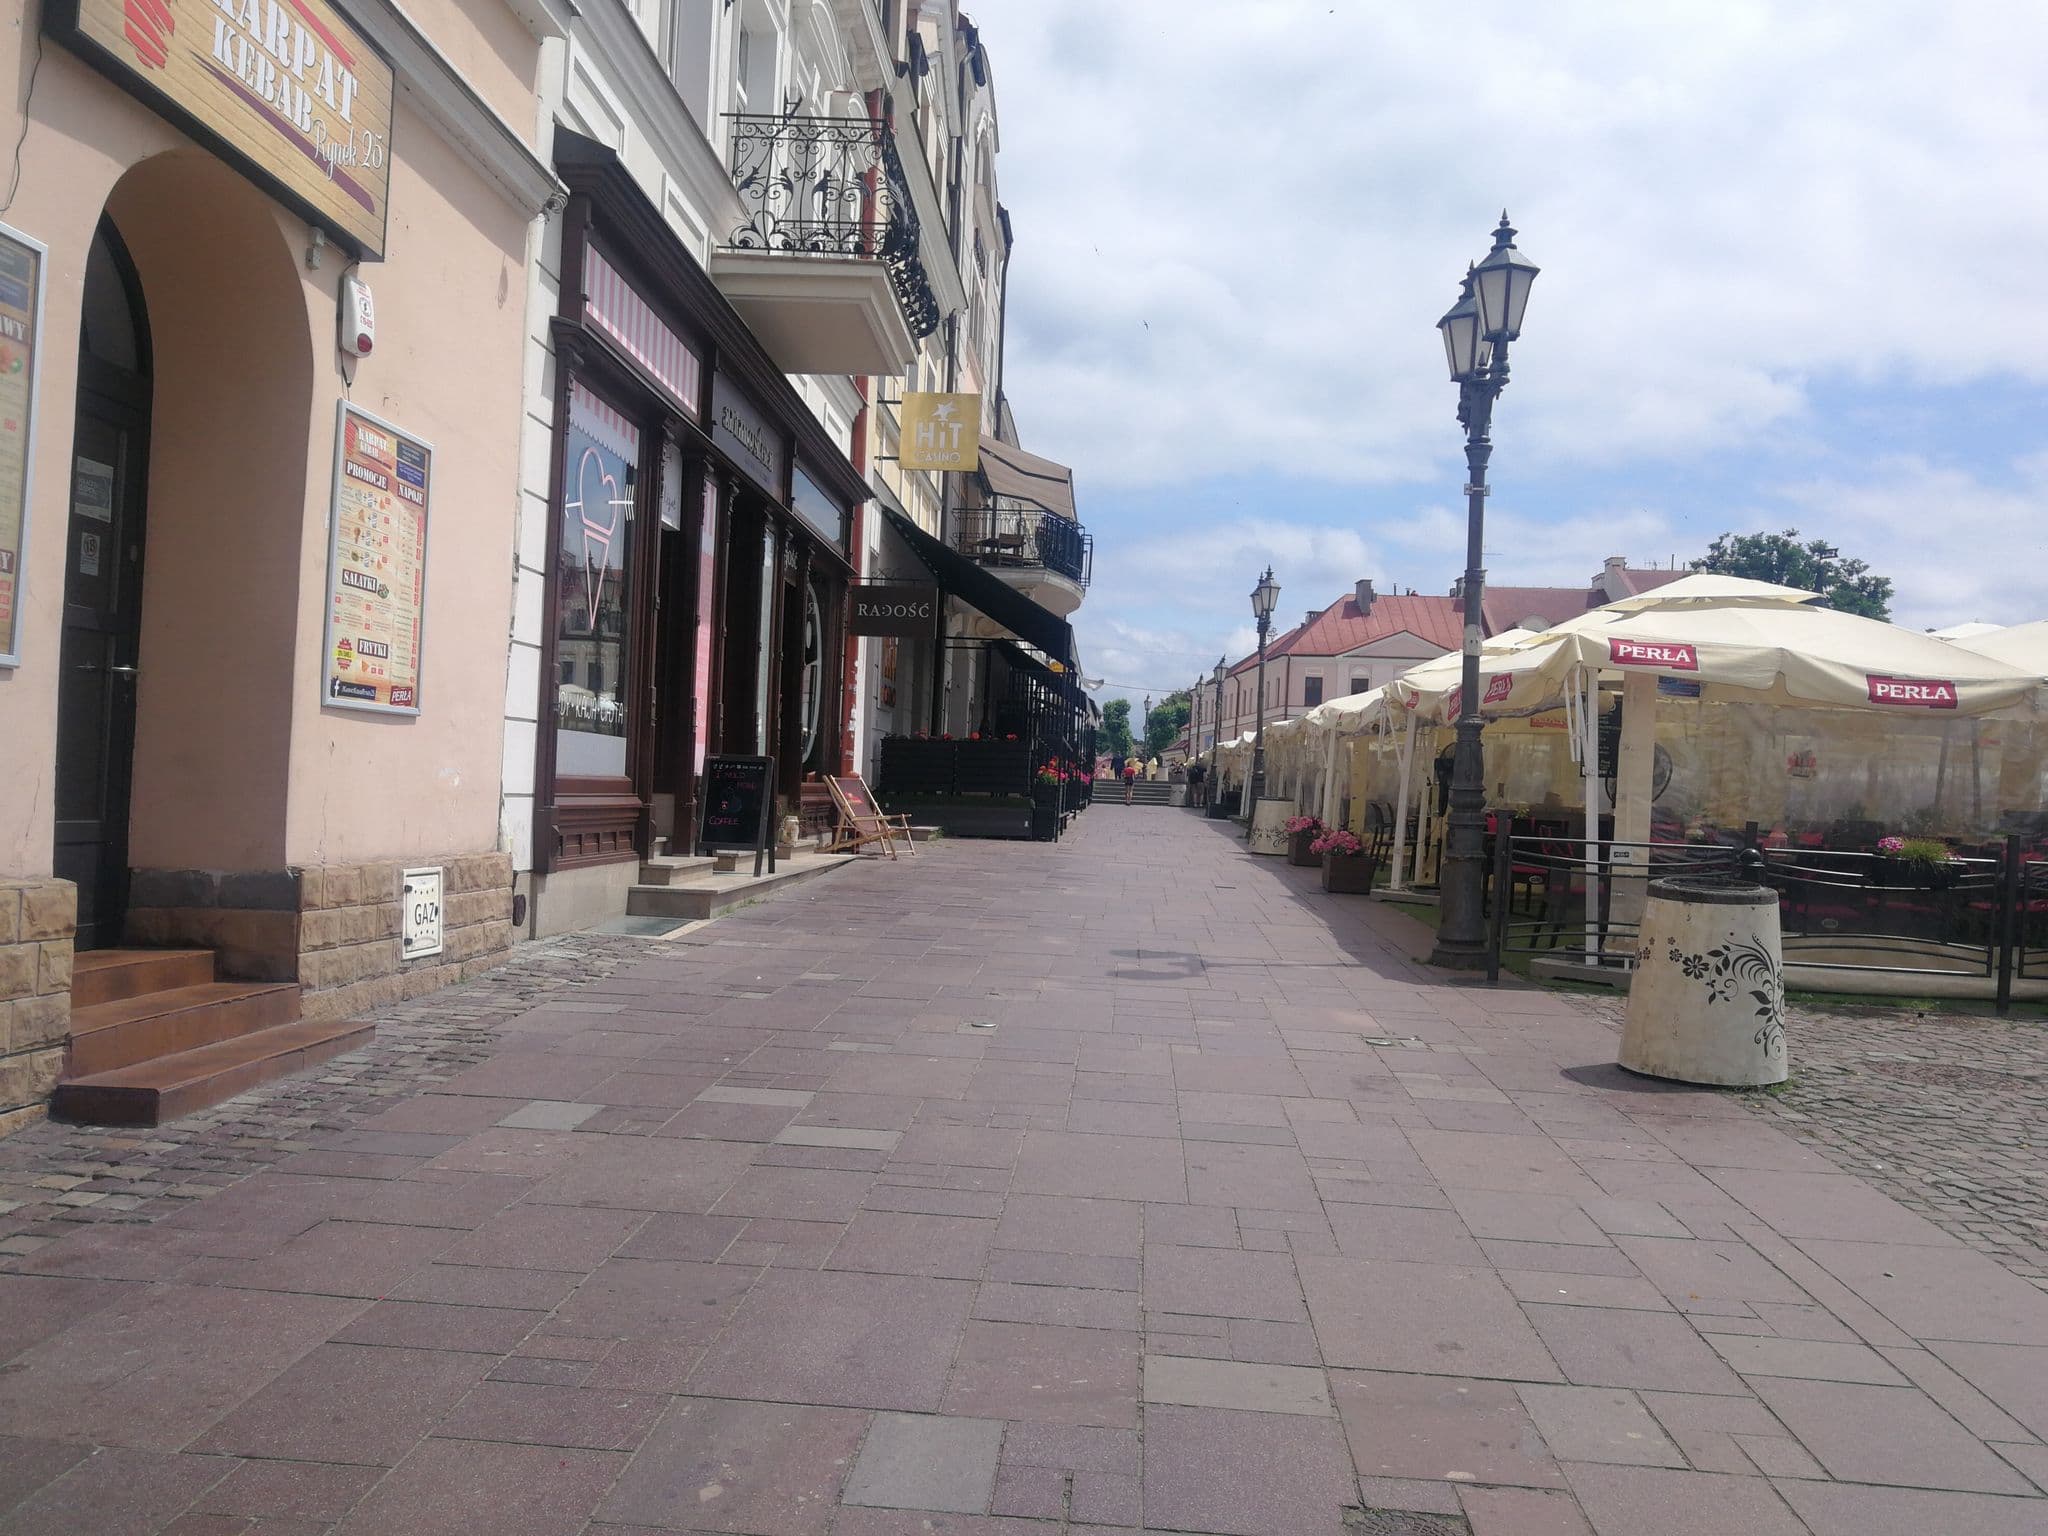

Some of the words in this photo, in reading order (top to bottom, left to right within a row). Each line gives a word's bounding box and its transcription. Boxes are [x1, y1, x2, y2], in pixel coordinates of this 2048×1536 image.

[211, 0, 359, 124] ARPAT
[212, 15, 312, 133] KEBAB
[313, 118, 357, 181] Rynek
[361, 130, 383, 169] 25
[347, 461, 387, 489] PROMOCJE
[399, 484, 425, 505] NAPOJE
[359, 641, 387, 657] FRYTKI
[1618, 644, 1691, 663] PERŁA
[1876, 683, 1951, 700] PERŁA
[414, 902, 435, 926] GAZ
